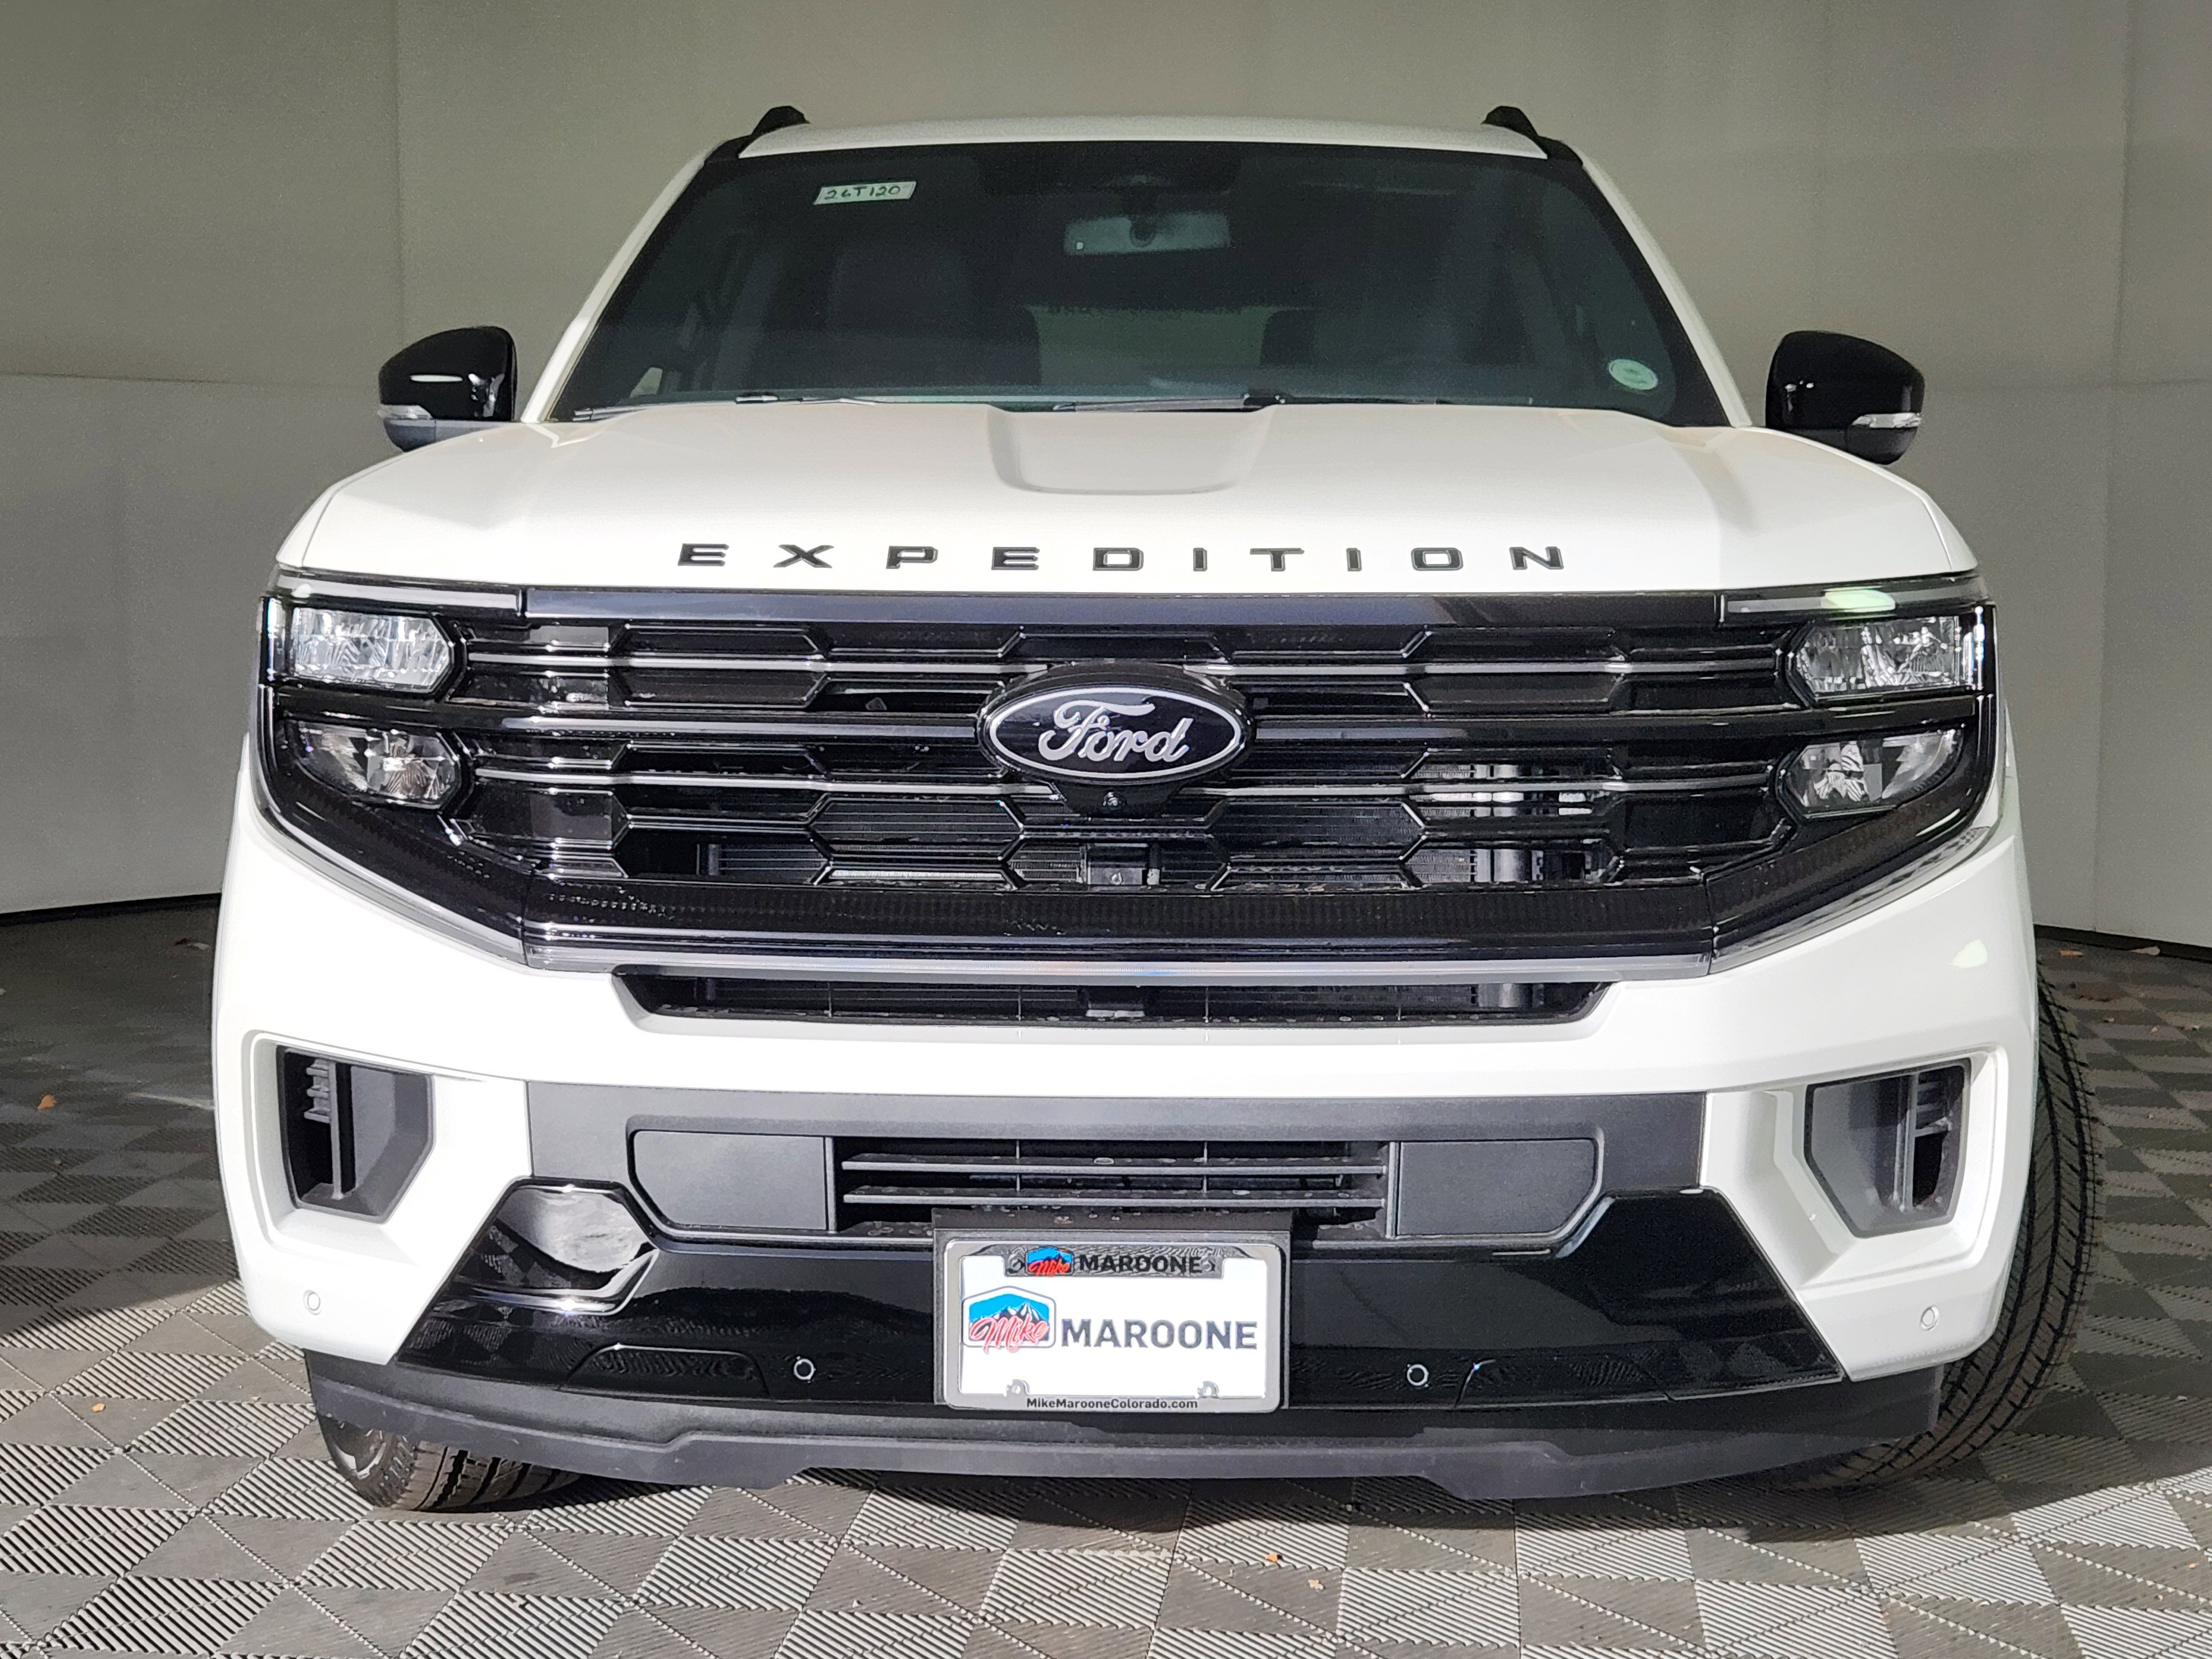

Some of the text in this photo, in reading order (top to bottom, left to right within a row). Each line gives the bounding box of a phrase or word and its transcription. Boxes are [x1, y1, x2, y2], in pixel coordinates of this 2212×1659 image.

[677, 543, 1564, 571] EXPEDITION
[1038, 700, 1194, 763] Ford
[1027, 1254, 1202, 1276] Mike MAROONE
[969, 1313, 1258, 1354] Mike MAROONE
[1026, 1397, 1198, 1409] MikeMarooneColorado.com
